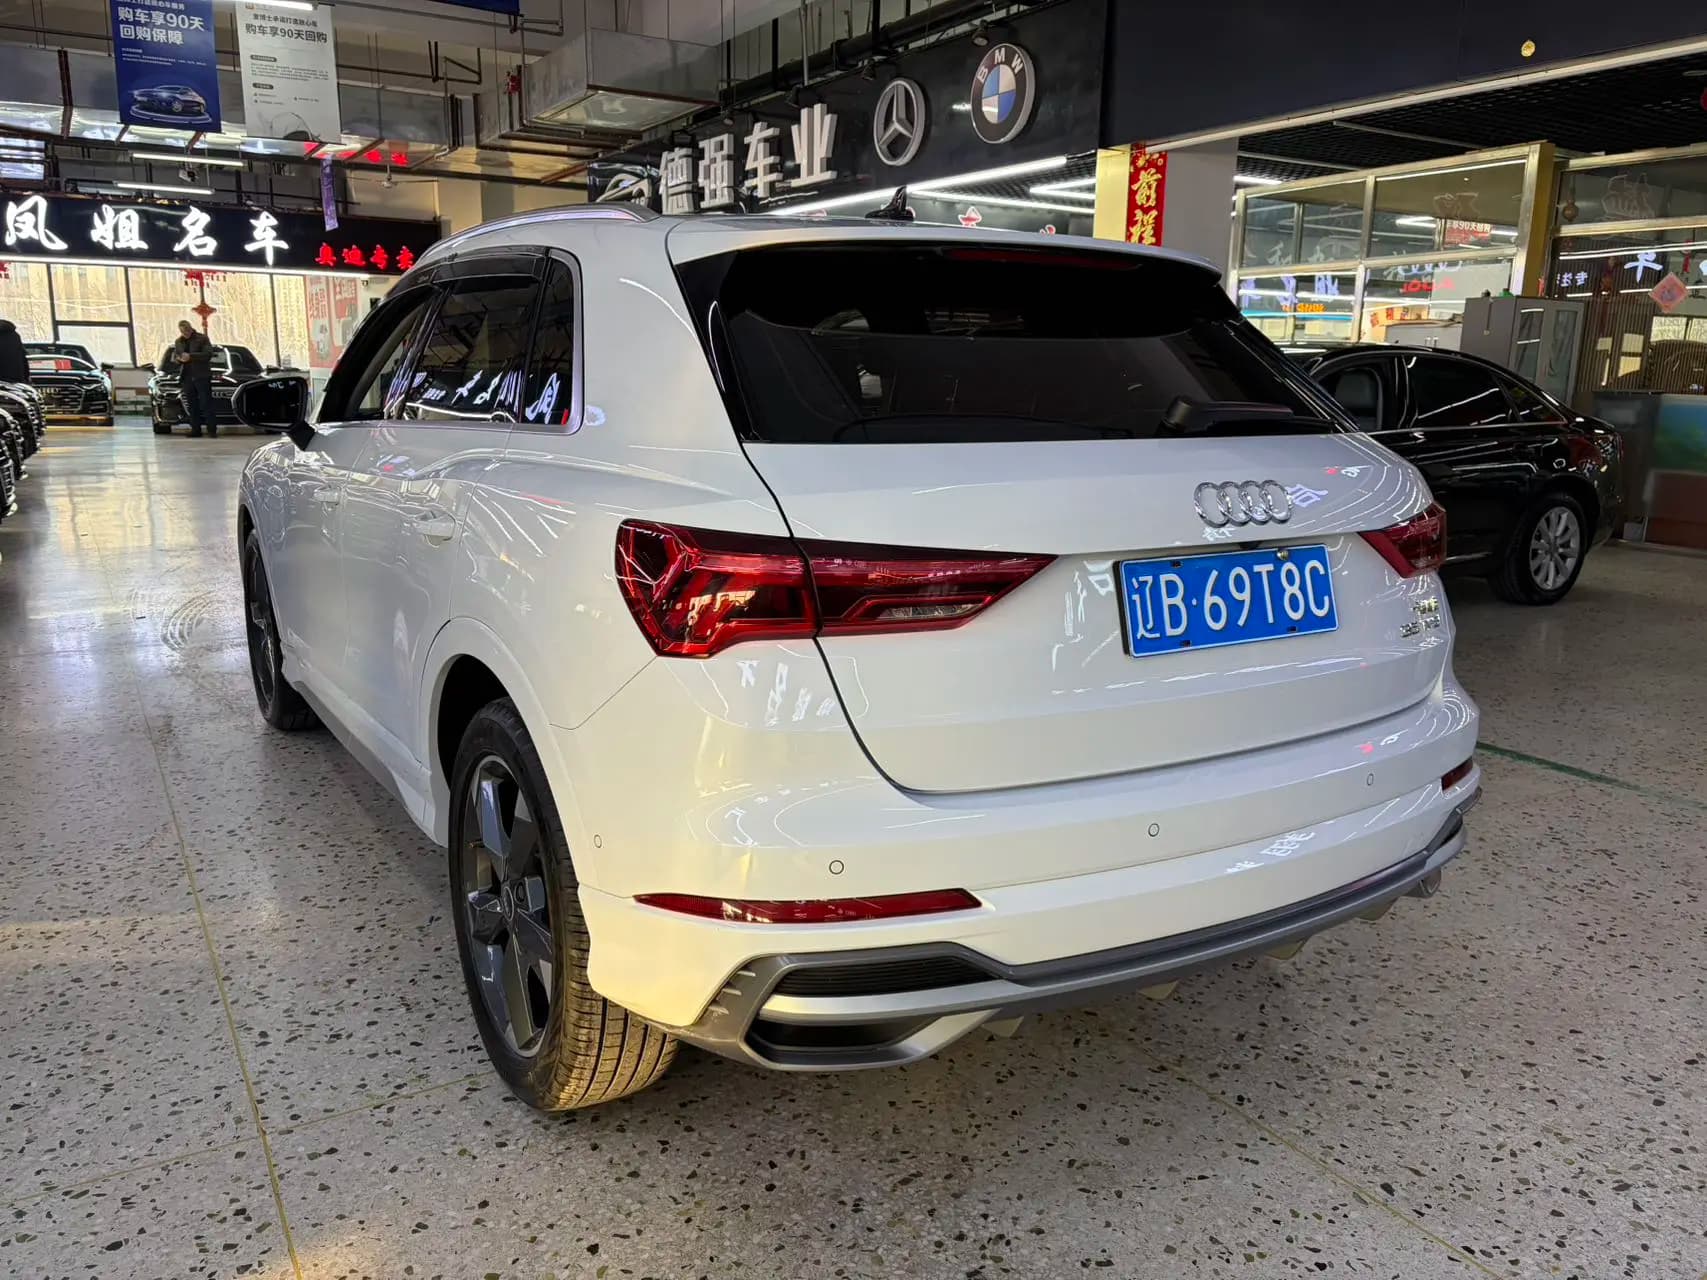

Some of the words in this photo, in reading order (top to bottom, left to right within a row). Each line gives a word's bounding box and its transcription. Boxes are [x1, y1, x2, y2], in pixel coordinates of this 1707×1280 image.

[118, 6, 205, 31] 购车享90天
[245, 23, 328, 43] 购车享90天回购
[120, 24, 184, 45] 回购保障
[976, 47, 1024, 83] BMW
[659, 103, 838, 214] 德强车业
[5, 194, 290, 266] 凤姐名车
